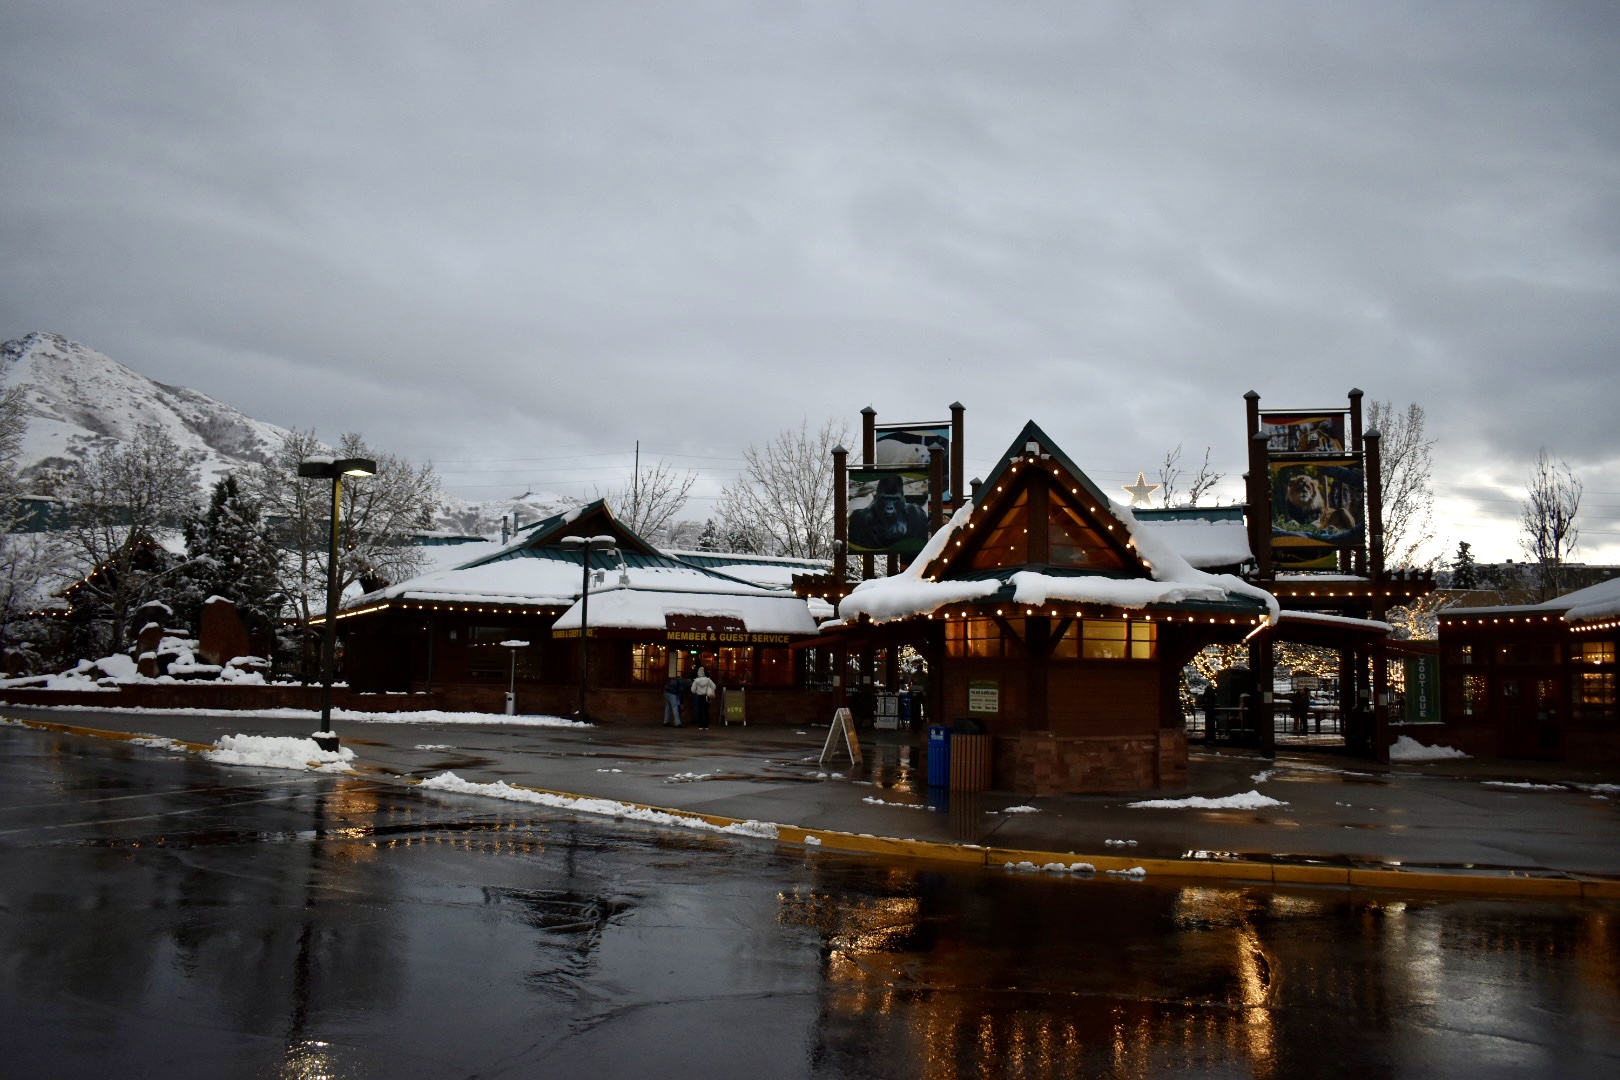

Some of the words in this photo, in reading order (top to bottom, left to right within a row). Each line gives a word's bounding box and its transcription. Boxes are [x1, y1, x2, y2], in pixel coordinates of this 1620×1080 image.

[667, 631, 707, 641] MEMBER
[709, 631, 717, 641] &
[719, 633, 750, 642] GUEST
[751, 634, 790, 643] SERVICE
[1418, 658, 1427, 717] ZOOTIQUE
